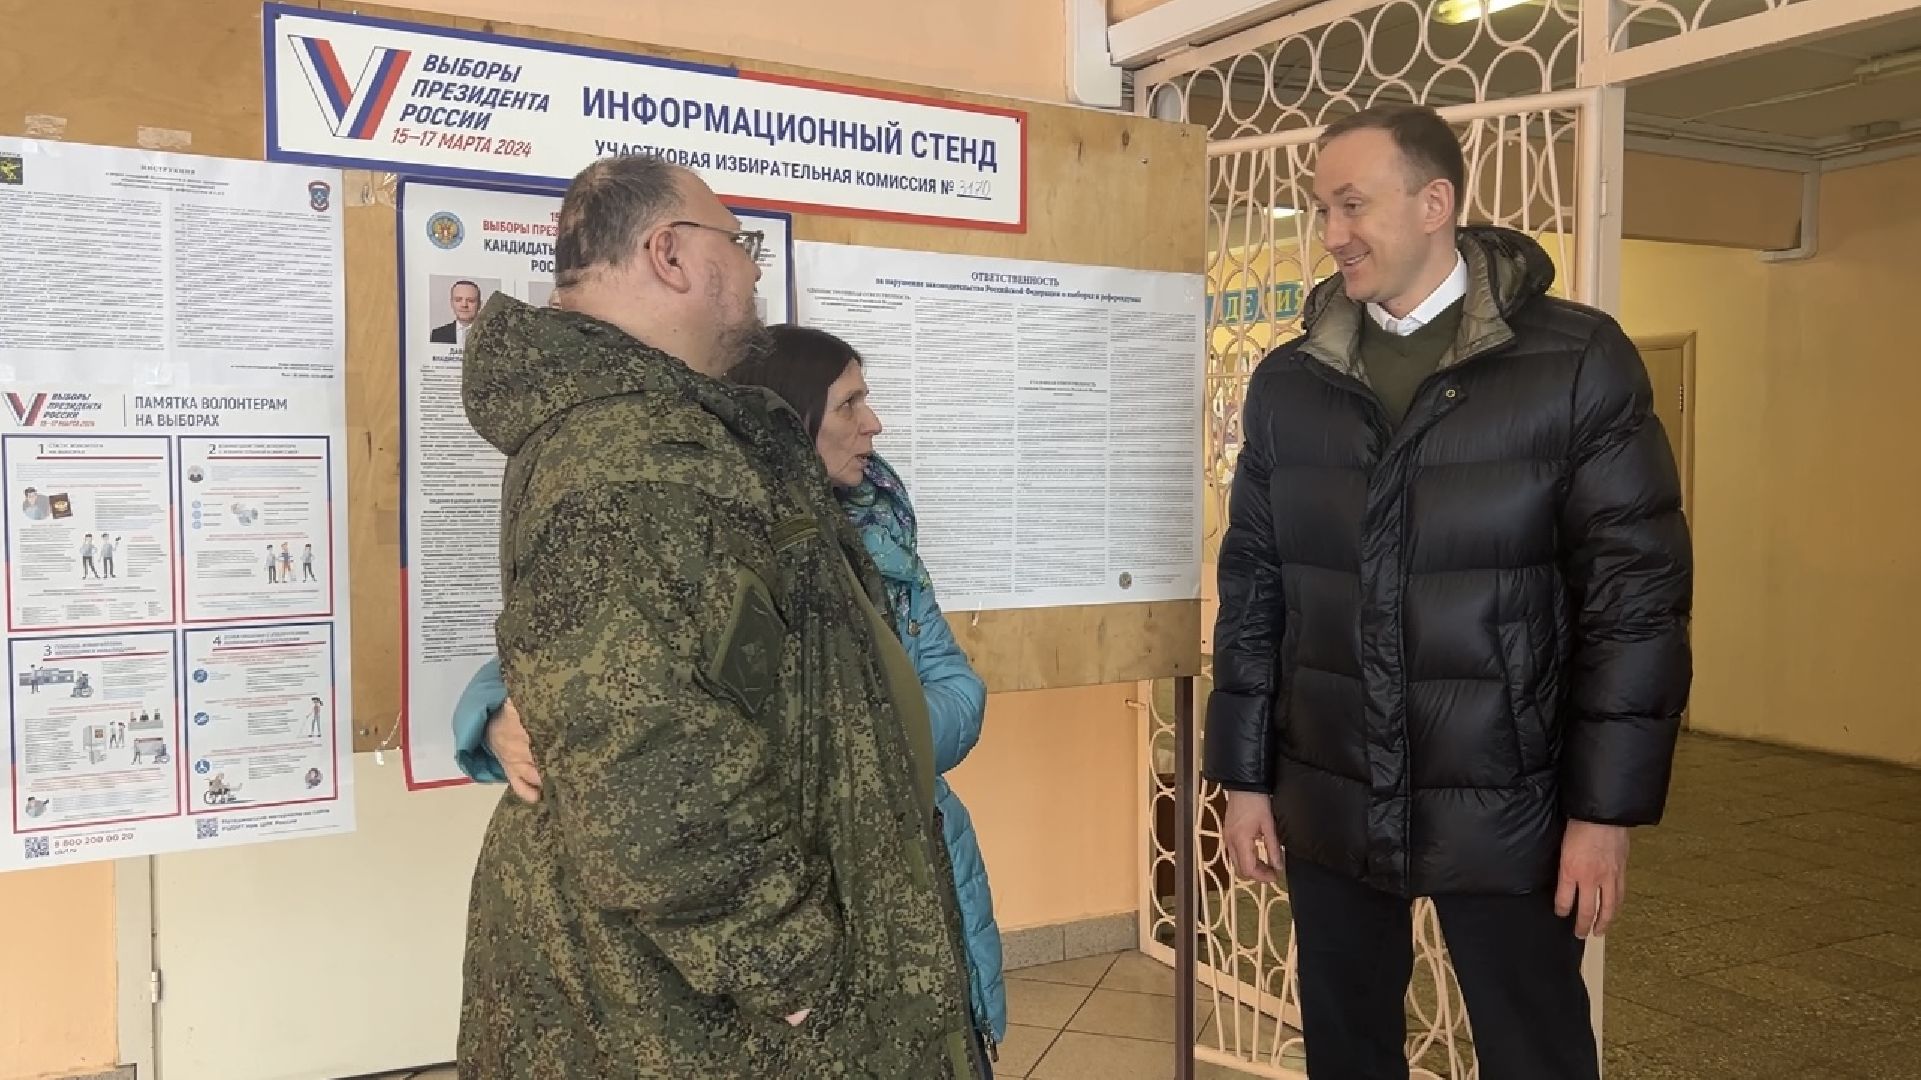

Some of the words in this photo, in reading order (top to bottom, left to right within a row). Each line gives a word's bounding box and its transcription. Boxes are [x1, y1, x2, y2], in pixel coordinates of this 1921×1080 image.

[422, 54, 522, 83] ВЫБОРЫ
[411, 79, 550, 112] ПРЕЗИДЕНТА
[400, 104, 492, 131] РОССИИ
[582, 86, 903, 156] ИНФОРМАЦИОННЫЙ
[911, 130, 998, 173] СТЕНД
[438, 133, 492, 152] МАРТА
[494, 139, 532, 157] 2024
[715, 153, 852, 184] ИЗБИРАТЕЛЬНАЯ
[856, 169, 937, 193] КОМИССИЯ
[940, 179, 954, 195] №
[549, 211, 560, 222] 15
[483, 220, 530, 235] ВЫБОРЫ
[532, 223, 560, 237] ПРЕЗ
[530, 259, 556, 273] РОС
[135, 396, 198, 409] ПАМЯТКА
[202, 397, 288, 411] ВОЛОНТЕРАМ
[135, 413, 155, 427] НА
[156, 413, 220, 428] ВЫБОРАХ
[38, 443, 44, 455] 1
[208, 443, 216, 455] 2
[43, 644, 53, 657] 3
